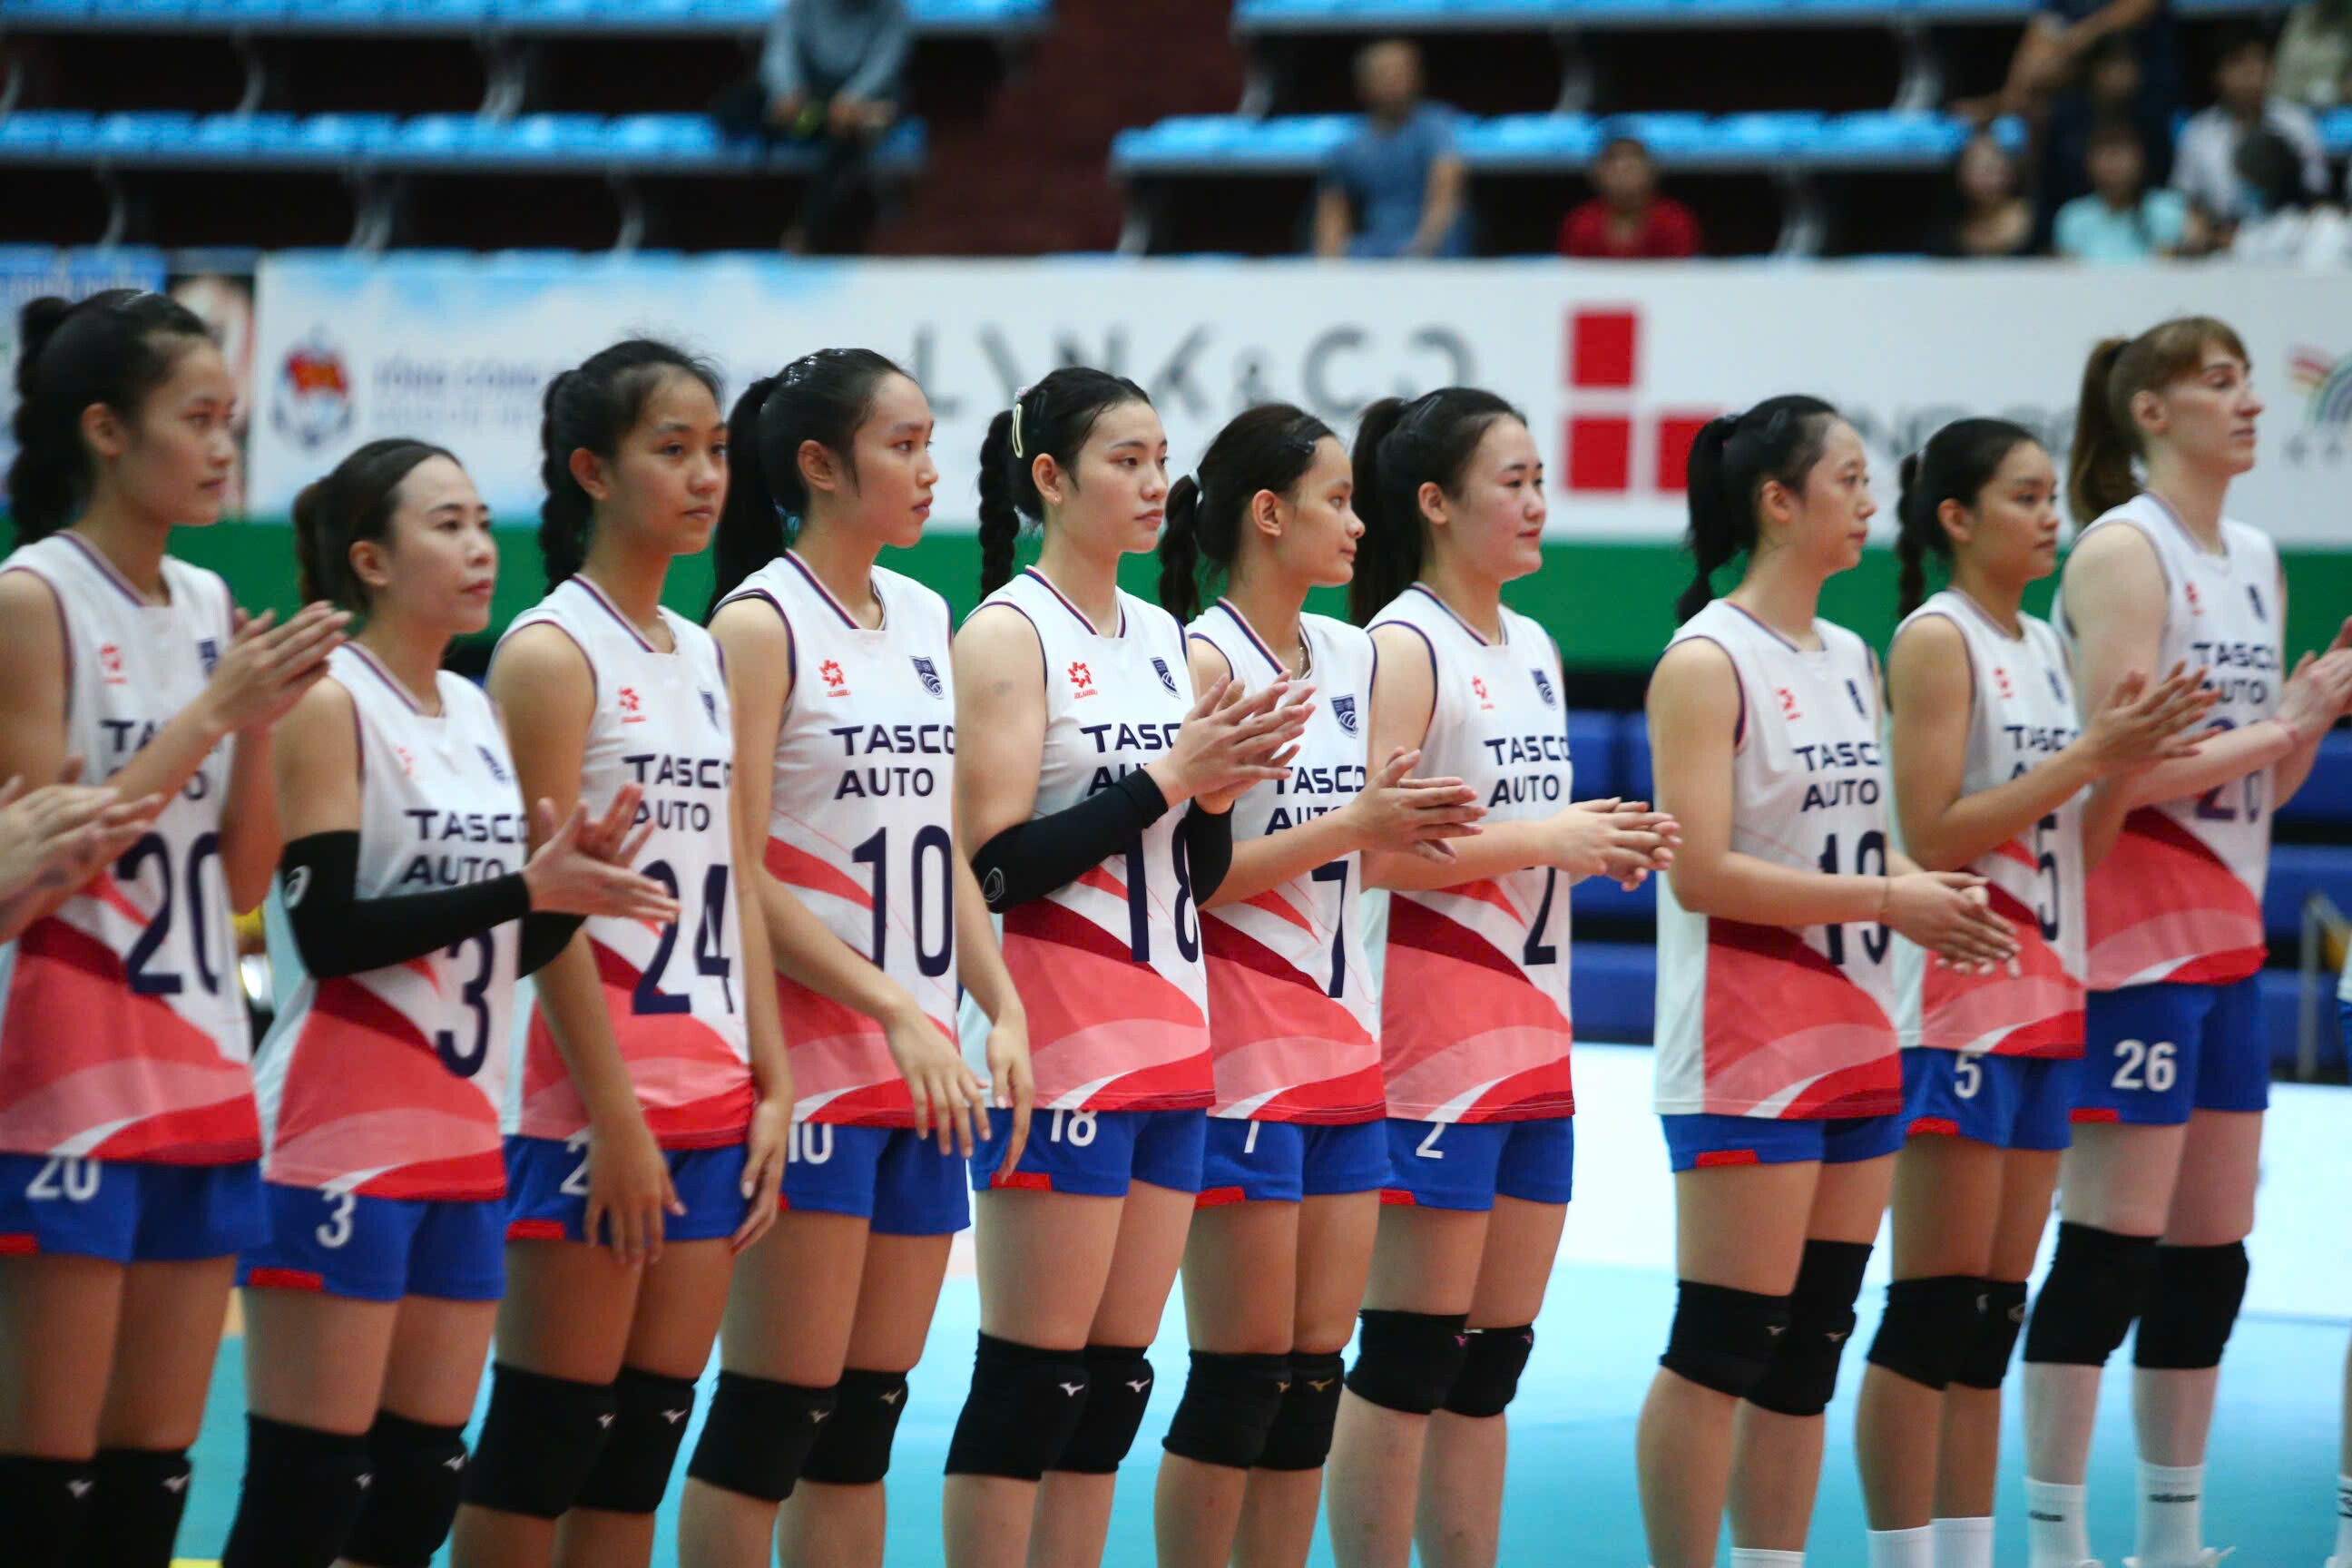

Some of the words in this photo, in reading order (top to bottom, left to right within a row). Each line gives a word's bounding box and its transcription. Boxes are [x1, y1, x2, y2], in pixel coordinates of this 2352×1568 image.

[1079, 722, 1182, 753] TASC
[1793, 741, 1881, 771] TASC
[2003, 725, 2082, 752] TASC
[833, 766, 935, 800] AUTO
[1487, 774, 1560, 808] AUTO
[1800, 778, 1879, 812] AUTO
[401, 855, 505, 887] AUTO
[2035, 813, 2059, 942] 5
[851, 824, 954, 978] 10
[1523, 866, 1558, 966] 2
[631, 858, 734, 1015] 24
[1310, 859, 1349, 999] 7
[436, 929, 495, 1079] 3
[1954, 1052, 1984, 1100] 5
[2112, 1038, 2177, 1092] 26
[1050, 1108, 1098, 1148] 18
[1415, 1122, 1446, 1160] 2
[25, 1157, 102, 1202] 20
[316, 1191, 357, 1250] 3
